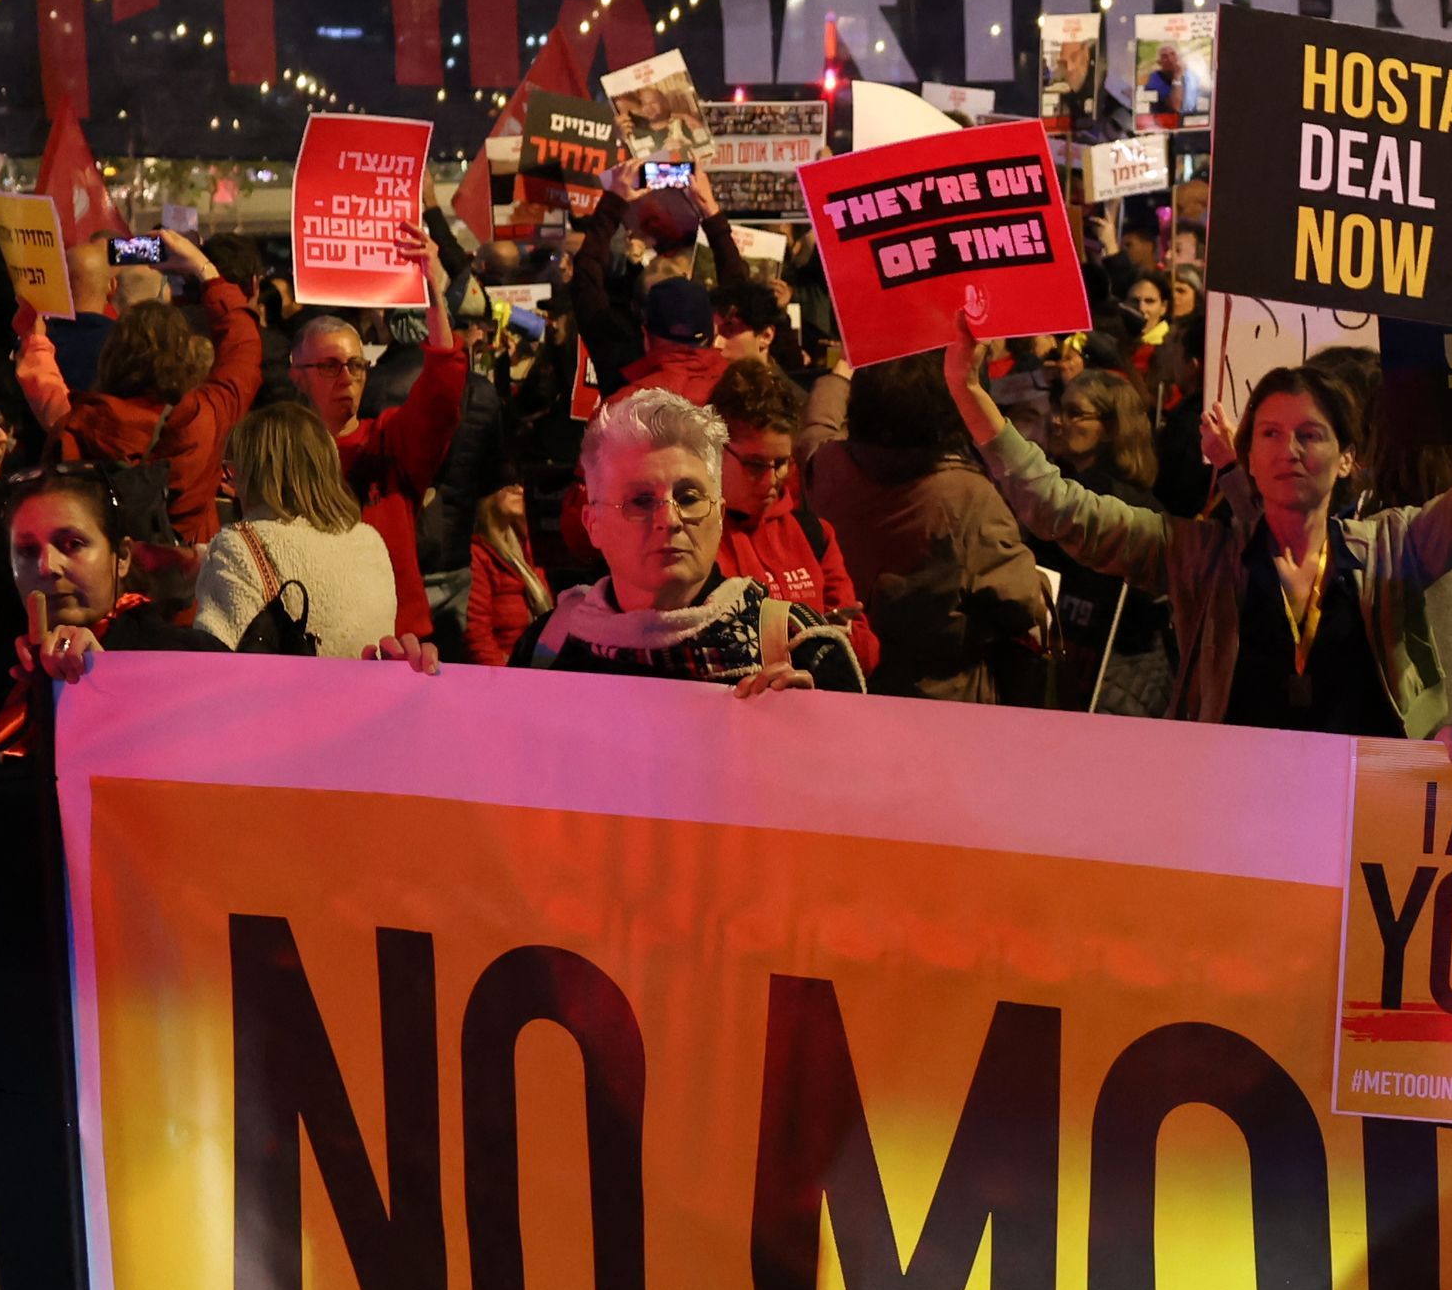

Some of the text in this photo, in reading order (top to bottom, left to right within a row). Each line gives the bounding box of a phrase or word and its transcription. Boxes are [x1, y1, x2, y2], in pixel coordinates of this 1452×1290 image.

[550, 113, 612, 141] שבויים
[338, 150, 416, 176] תעצרו
[529, 135, 608, 177] מחיר
[1298, 121, 1437, 210] DEAL
[332, 194, 412, 220] העולם
[375, 176, 412, 197] את
[822, 172, 982, 230] THEY'RE
[986, 164, 1043, 199] OUT
[307, 242, 347, 262] שם
[877, 219, 1047, 279] OF TIME!
[1293, 205, 1435, 299] NOW
[1423, 781, 1438, 855] I
